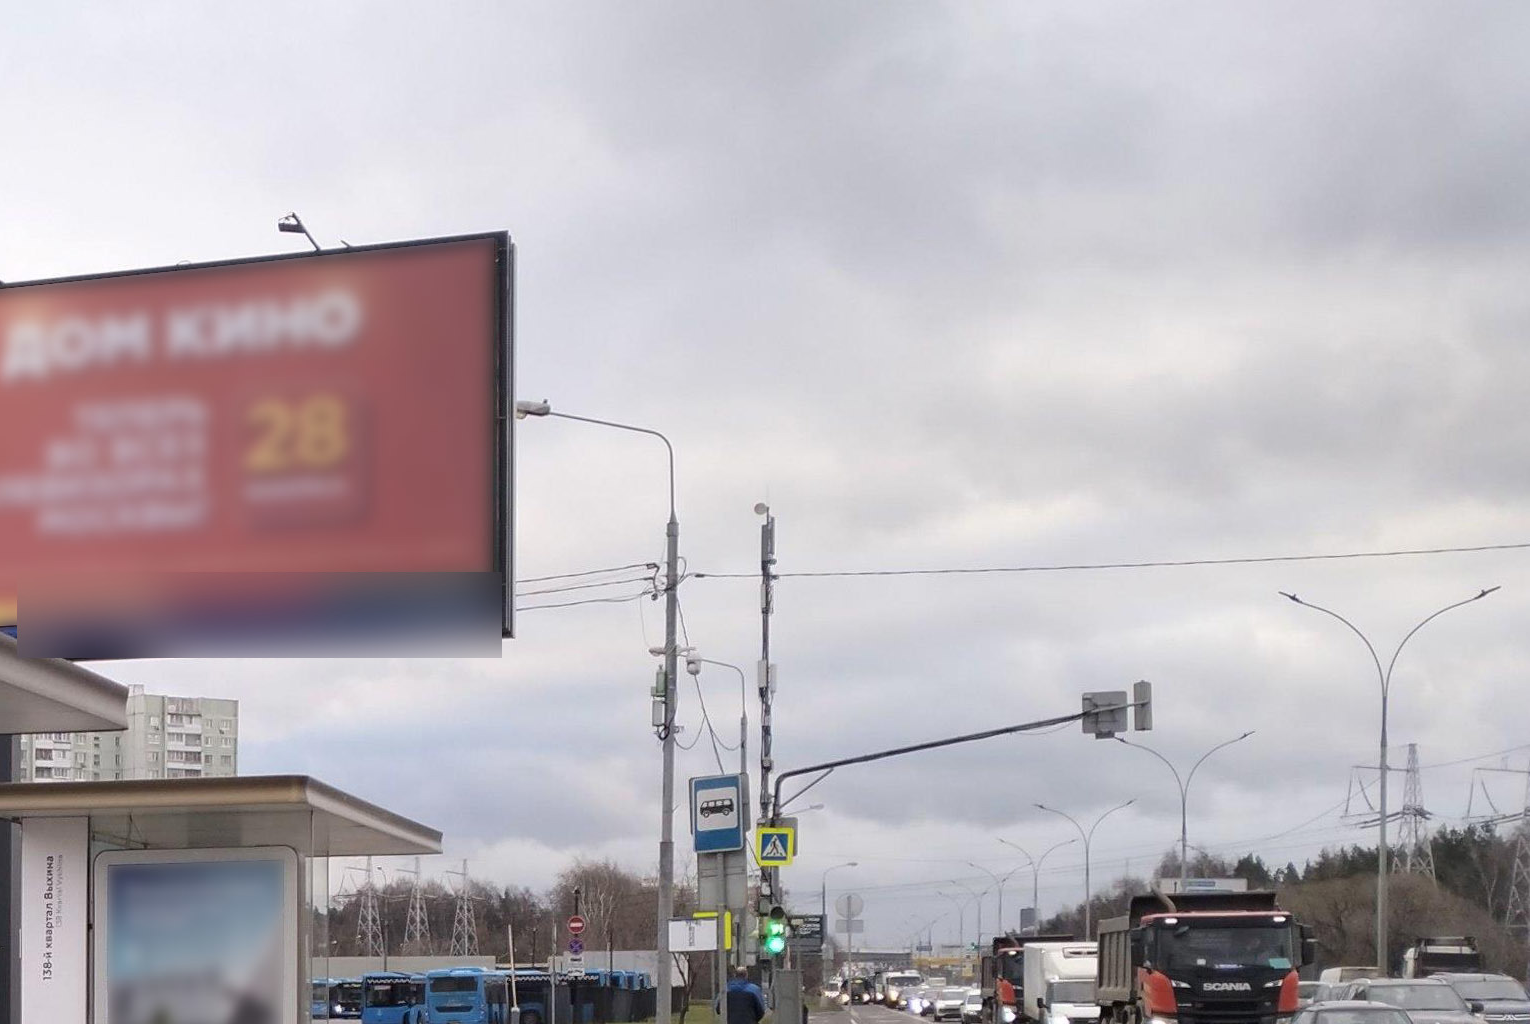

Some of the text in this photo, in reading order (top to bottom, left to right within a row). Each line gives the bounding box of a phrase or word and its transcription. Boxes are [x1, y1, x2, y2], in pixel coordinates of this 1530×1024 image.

[43, 855, 55, 981] 138-й квартал Выхина
[1203, 982, 1252, 991] SCANIA
